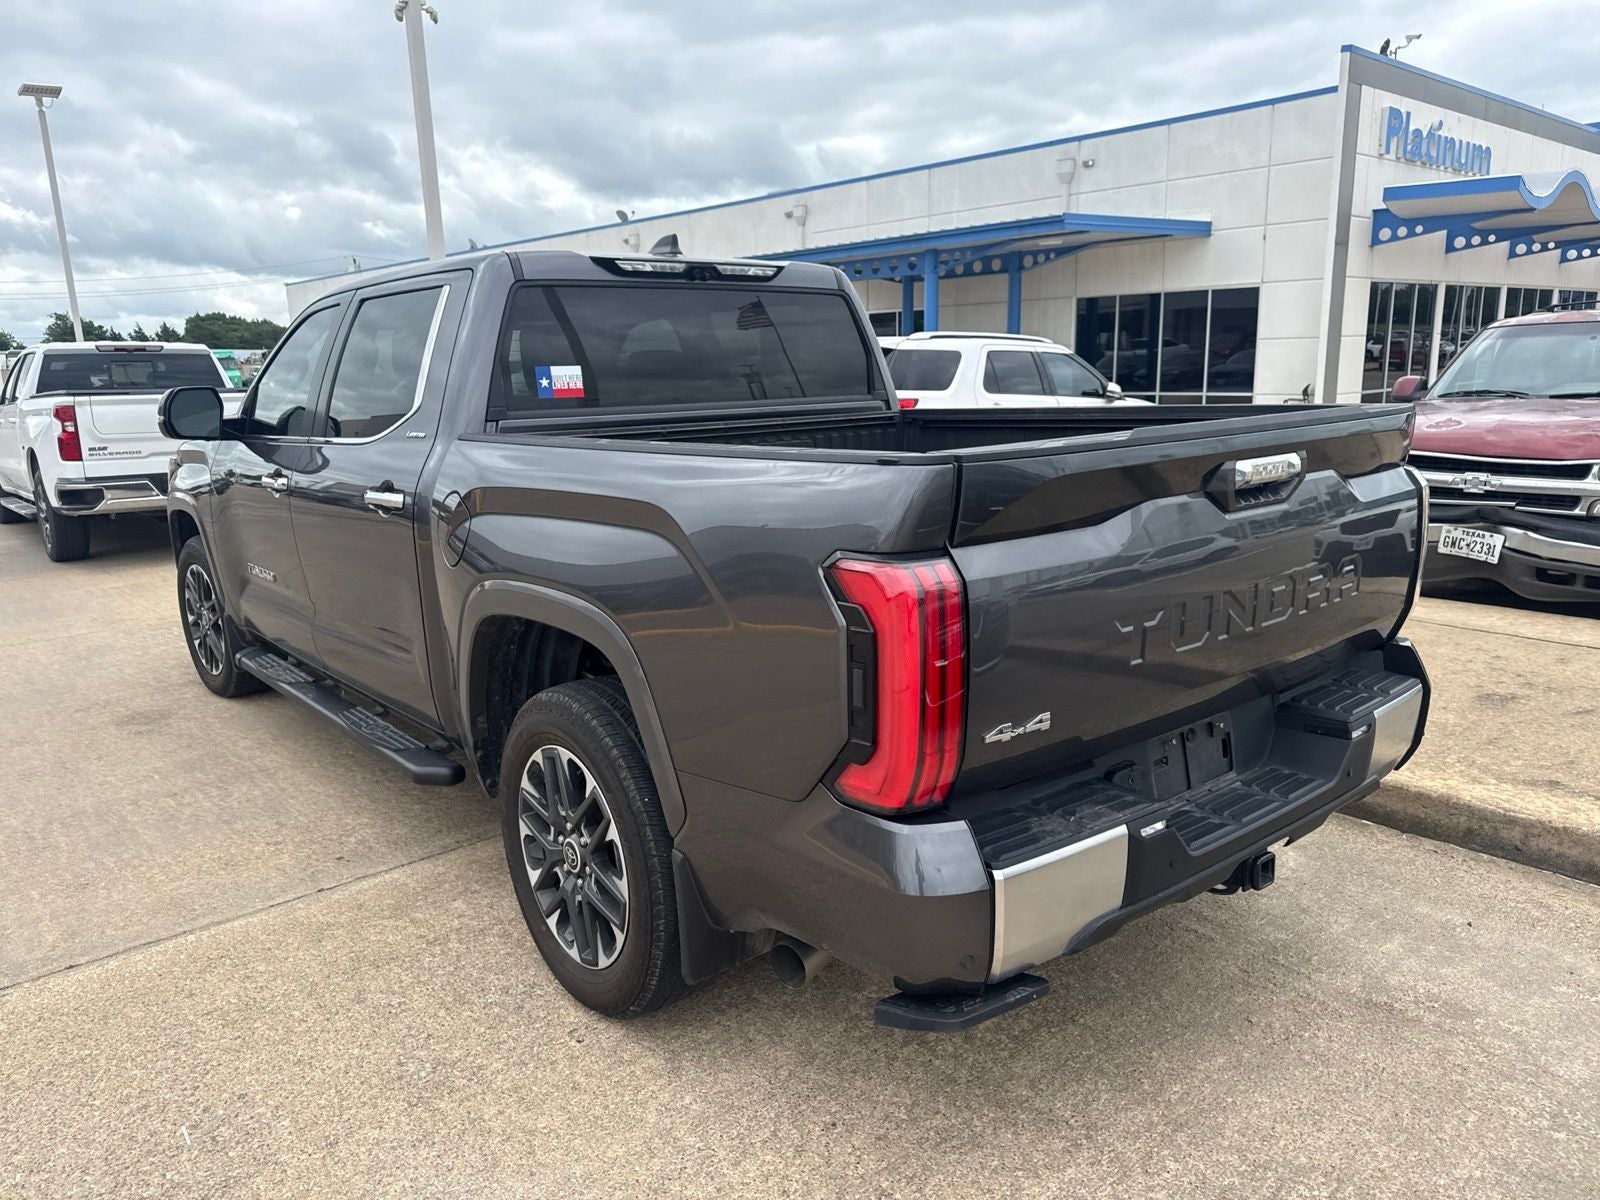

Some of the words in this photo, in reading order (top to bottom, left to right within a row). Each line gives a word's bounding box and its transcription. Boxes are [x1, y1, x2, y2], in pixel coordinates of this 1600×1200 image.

[1383, 105, 1492, 176] Platinum
[1461, 529, 1487, 540] TEXAS
[1114, 553, 1363, 667] TUNDRA
